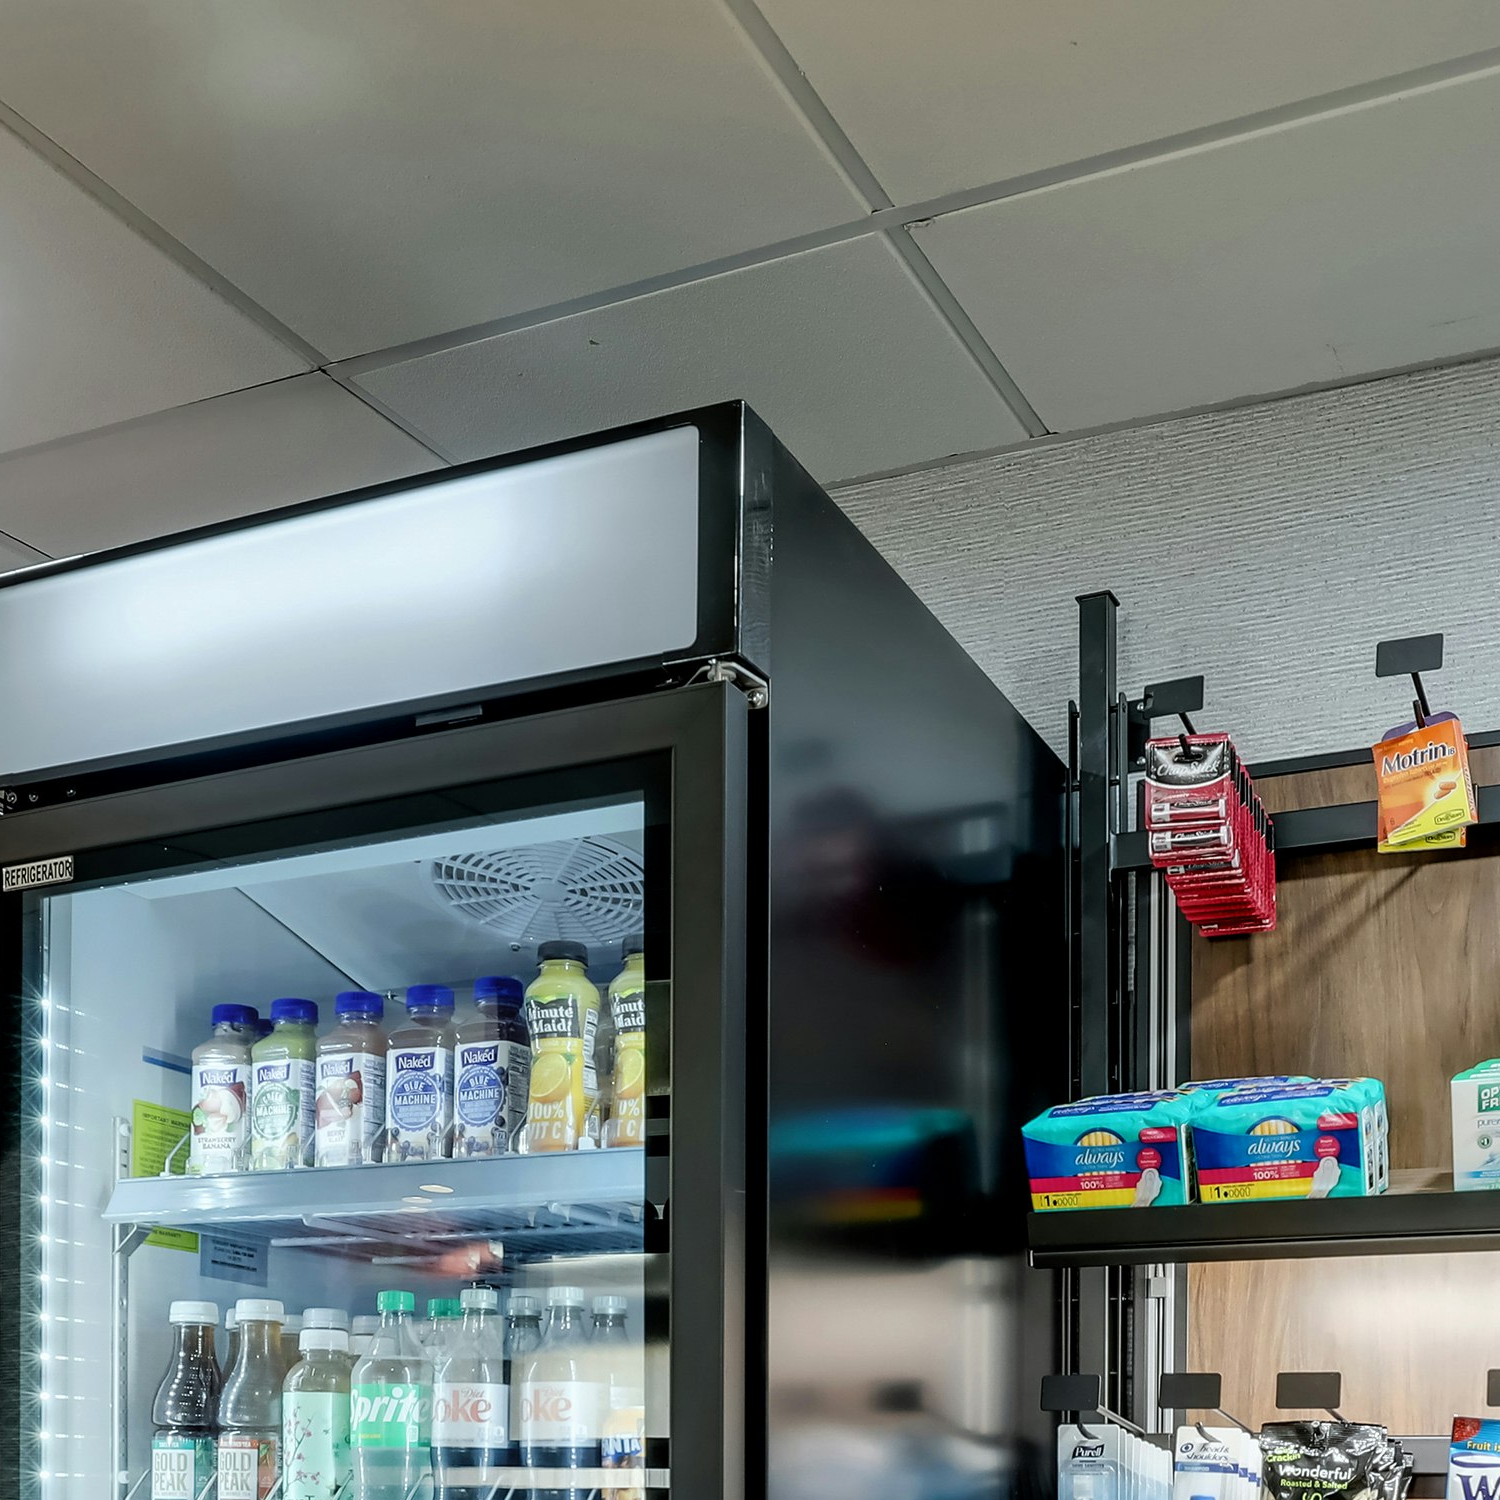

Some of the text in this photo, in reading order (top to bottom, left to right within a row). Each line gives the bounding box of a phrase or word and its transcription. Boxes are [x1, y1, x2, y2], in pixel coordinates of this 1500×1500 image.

[1382, 741, 1448, 777] Motrin
[1156, 760, 1220, 777] ChapStick
[4, 860, 73, 887] REFRIGERATOR
[527, 1004, 574, 1020] Minute
[533, 1018, 568, 1034] Maid
[398, 1054, 432, 1070] Naked
[463, 1048, 496, 1064] Naked
[322, 1061, 350, 1076] Naked
[202, 1071, 234, 1085] Naked
[403, 1081, 425, 1091] BLUE
[468, 1075, 491, 1087] BLUE
[394, 1093, 437, 1106] MACHINE
[460, 1088, 500, 1101] MACHINE
[256, 1104, 291, 1116] MACHINE
[529, 1101, 564, 1120] 100%
[552, 1120, 562, 1139] C
[197, 1136, 237, 1144] STRAWBERRY
[202, 1142, 231, 1150] BANANA
[1247, 1139, 1301, 1156] always
[1075, 1149, 1125, 1166] always
[1253, 1170, 1279, 1180] 100%
[1080, 1180, 1105, 1190] 100%
[1074, 1446, 1103, 1458] Purell
[1466, 1440, 1492, 1452] Fruit
[154, 1452, 188, 1472] GOLD
[219, 1452, 252, 1472] GOLD
[154, 1472, 188, 1491] PEAK
[218, 1472, 252, 1491] PEAK
[1280, 1479, 1313, 1488] Roasted
[1322, 1481, 1348, 1490] Salted
